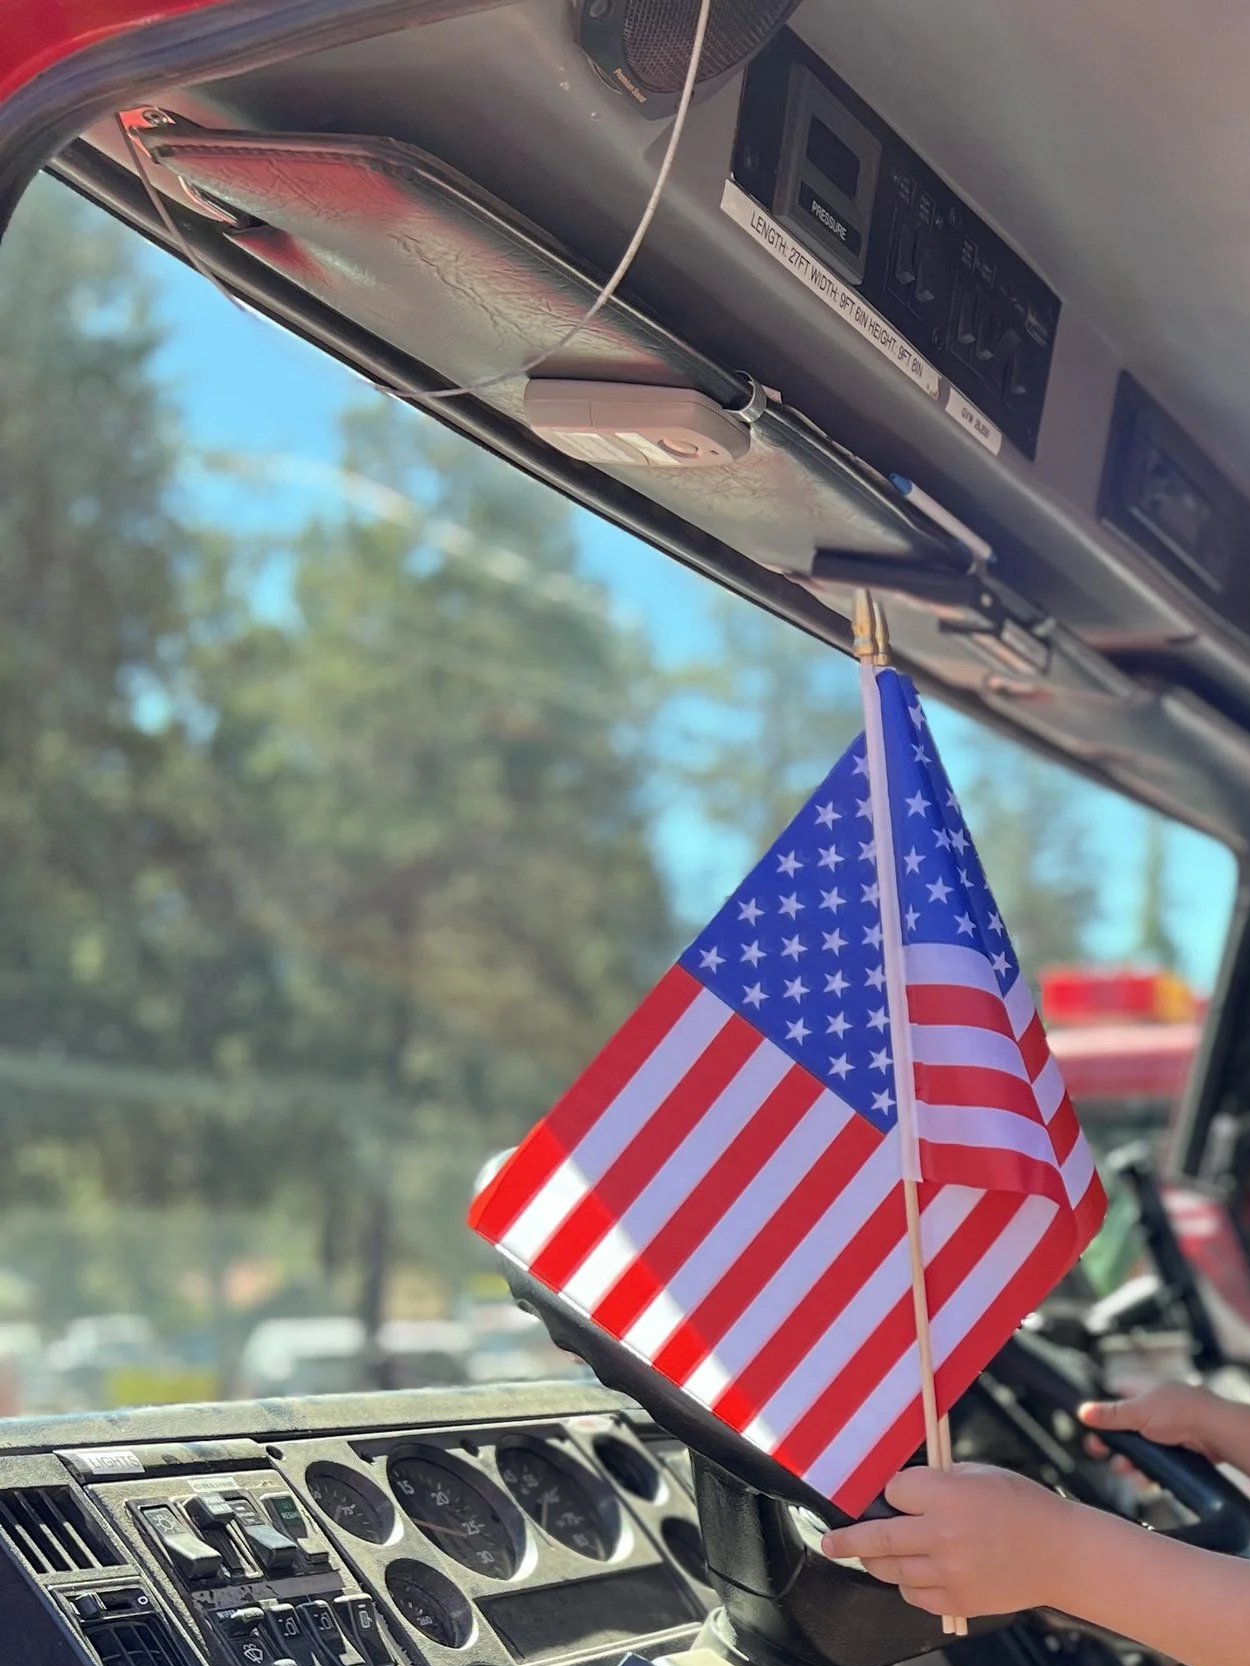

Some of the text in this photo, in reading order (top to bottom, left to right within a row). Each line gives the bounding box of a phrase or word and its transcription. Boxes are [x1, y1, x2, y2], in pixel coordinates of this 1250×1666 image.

[811, 200, 847, 241] PRESSURE
[750, 210, 788, 257] LENGTH:
[787, 247, 811, 277] 27FT
[811, 268, 840, 302] WIDTH:
[839, 294, 855, 320] 9FT
[855, 307, 868, 328] 6IN
[868, 319, 899, 355] HEIGHT:
[897, 347, 912, 369] 9FT
[90, 1455, 141, 1469] LIGHTS
[396, 1480, 415, 1495] 15
[431, 1491, 449, 1506] 20
[462, 1520, 480, 1535] 25
[476, 1550, 494, 1564] 30
